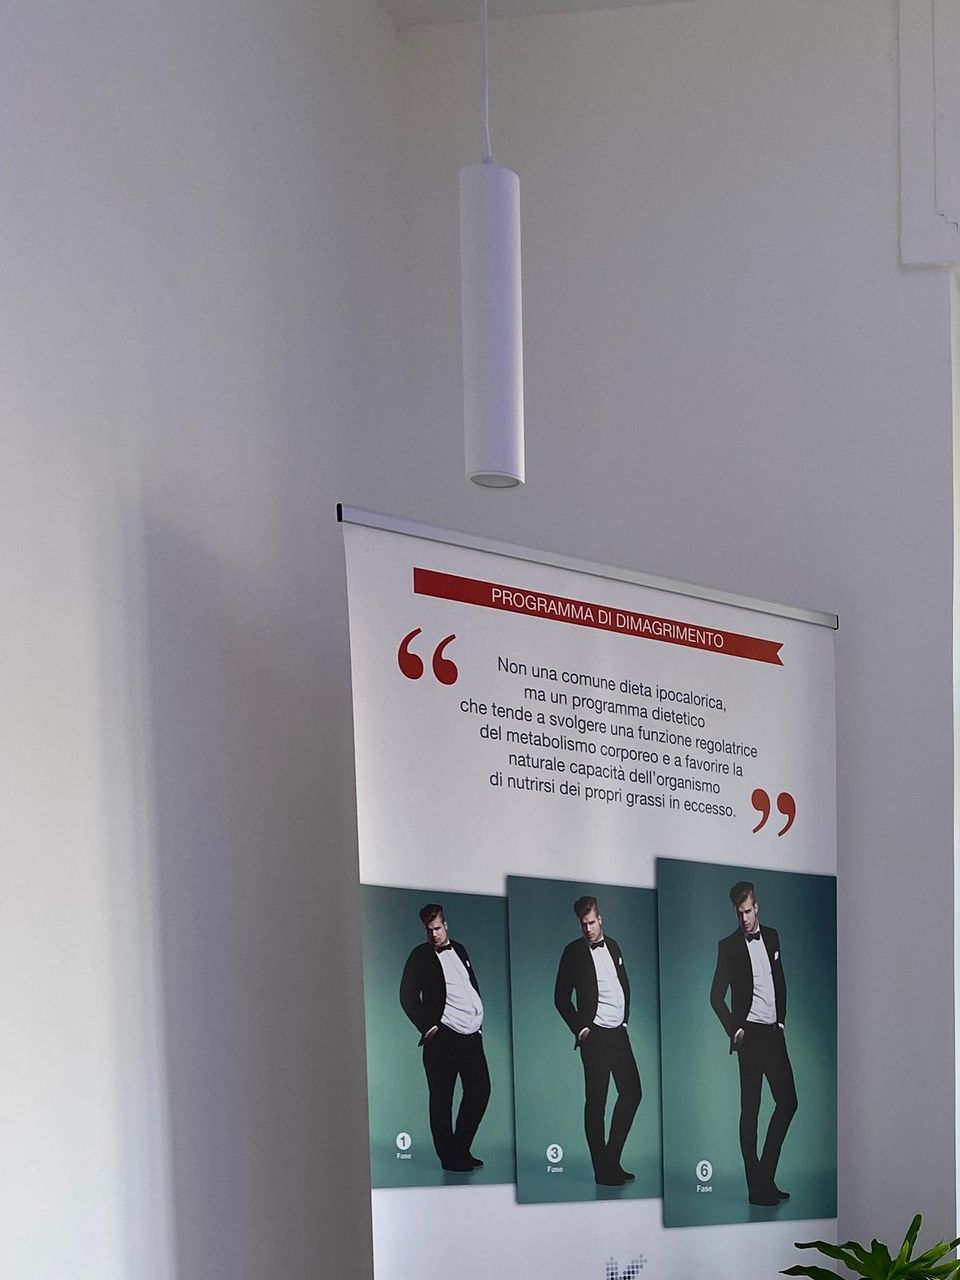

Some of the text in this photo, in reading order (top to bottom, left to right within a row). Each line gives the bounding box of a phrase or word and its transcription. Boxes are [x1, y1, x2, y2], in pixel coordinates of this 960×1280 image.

[491, 587, 724, 648] PROGRAMMA DI DIMAGRIMENTO
[497, 655, 726, 712] Non una comune dieta ipocalorica,
[459, 697, 757, 758] che tende a svolgere una funzione regolatrice
[523, 687, 705, 728] ma un programma dietetico
[479, 723, 743, 777] del metabolismo corporeo e a favorire la
[489, 770, 736, 817] di nutrirsi dei propri grassi in eccesso.
[508, 752, 720, 794] naturale capacità dell'organismo
[396, 1152, 412, 1160] Fase
[551, 1147, 559, 1159] 3
[701, 1163, 708, 1177] 6
